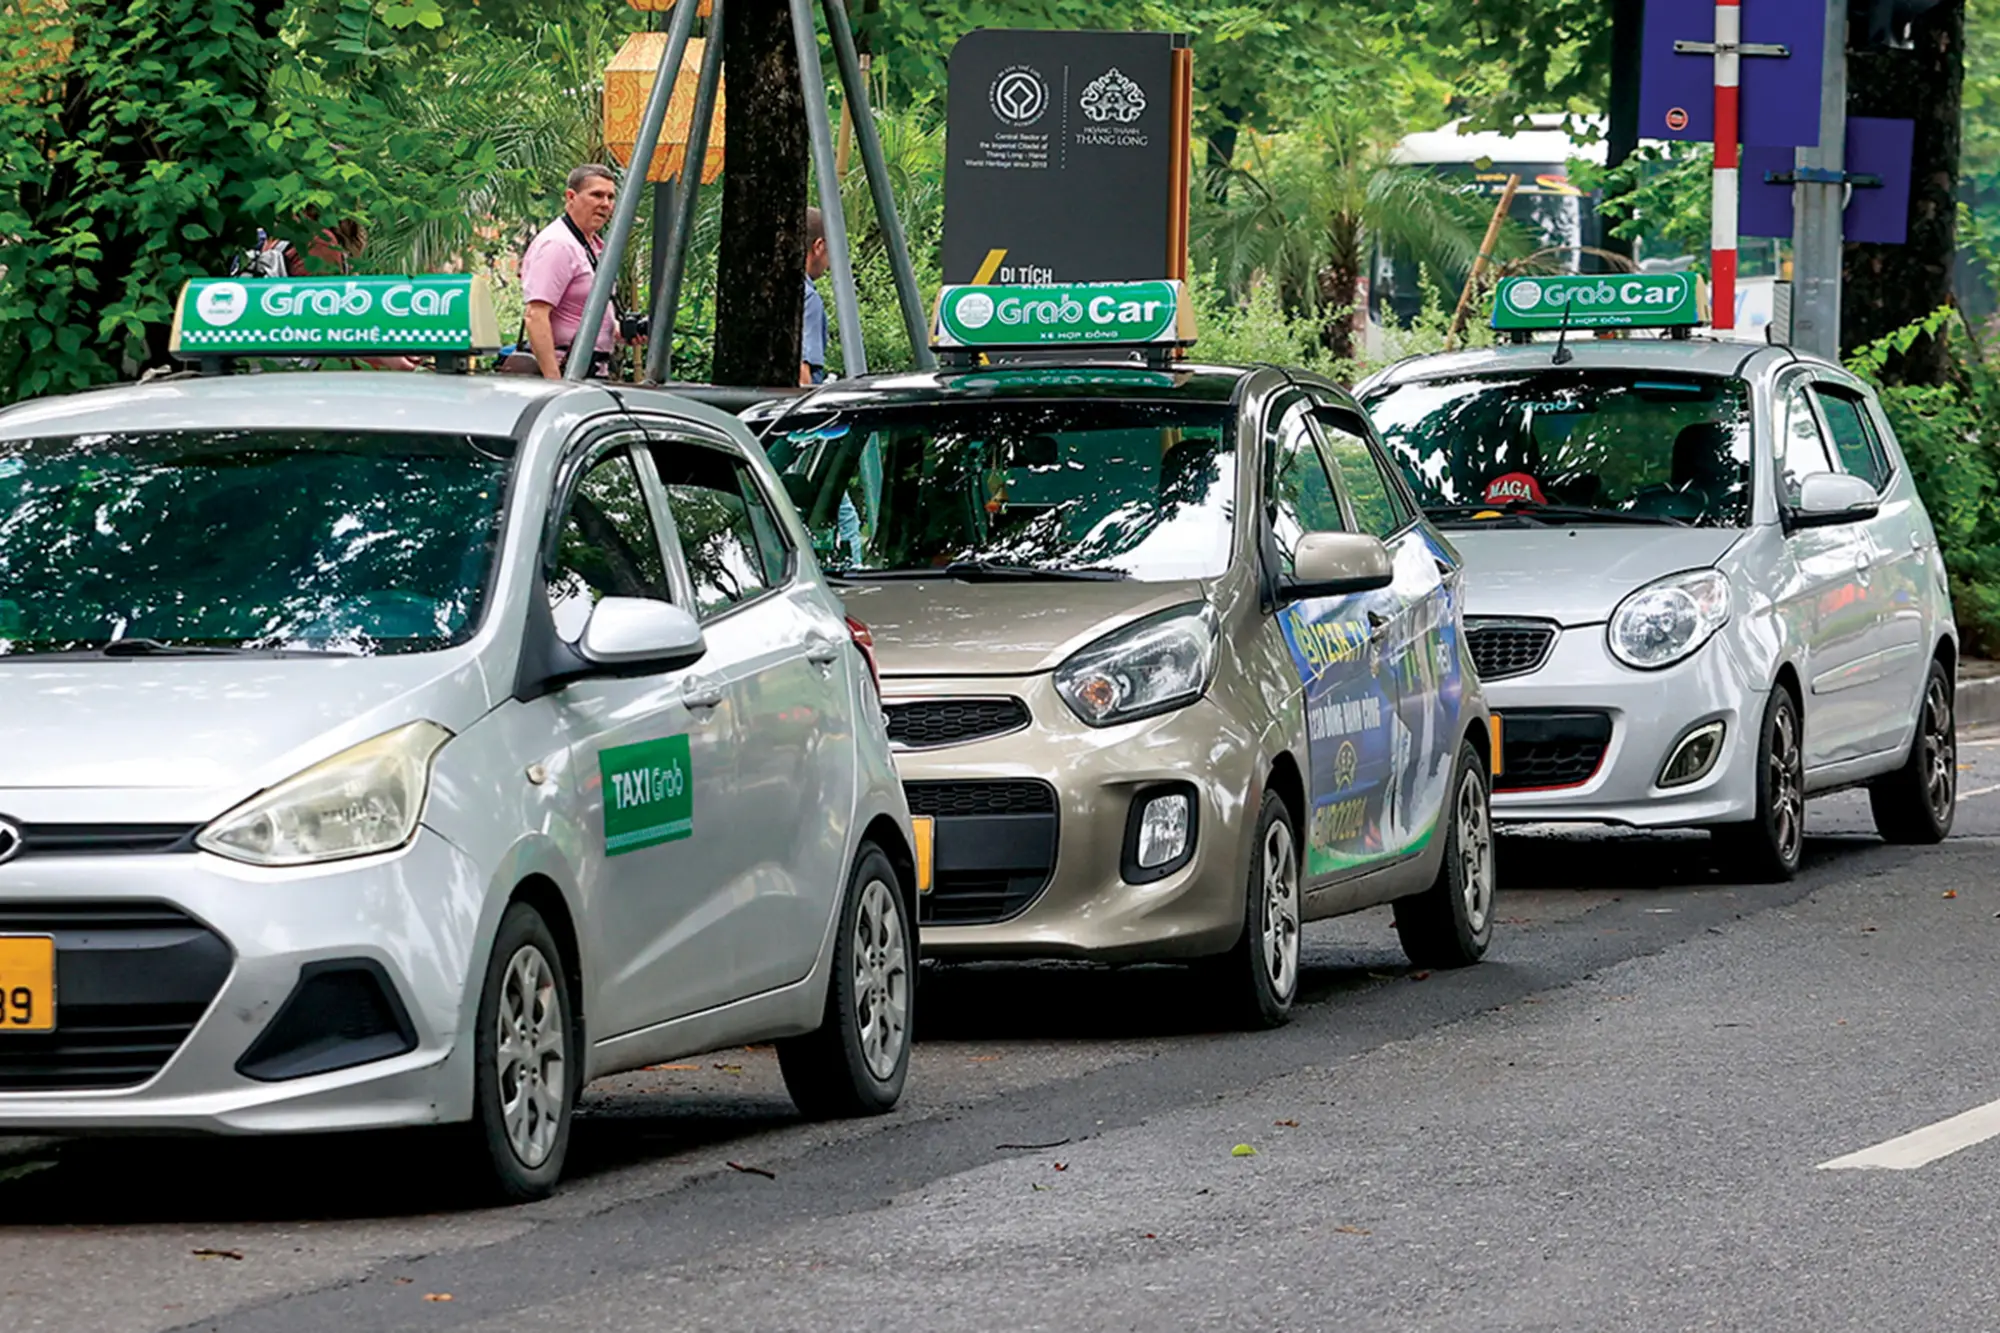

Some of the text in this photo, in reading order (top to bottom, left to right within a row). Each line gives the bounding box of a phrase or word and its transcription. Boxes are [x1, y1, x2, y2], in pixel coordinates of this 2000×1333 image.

[1118, 136, 1148, 146] LONG
[1001, 264, 1052, 284] DI TÍCH
[260, 281, 464, 317] Grab Car
[1544, 280, 1616, 306] Grab
[1620, 281, 1680, 305] Car
[996, 293, 1083, 325] Grab
[1088, 295, 1161, 324] Car
[268, 325, 380, 344] CÔNG NGHỆ
[1040, 331, 1054, 340] XE
[1487, 480, 1533, 501] MAGA
[611, 757, 684, 810] TAXI Grab
[0, 986, 33, 1026] 9
